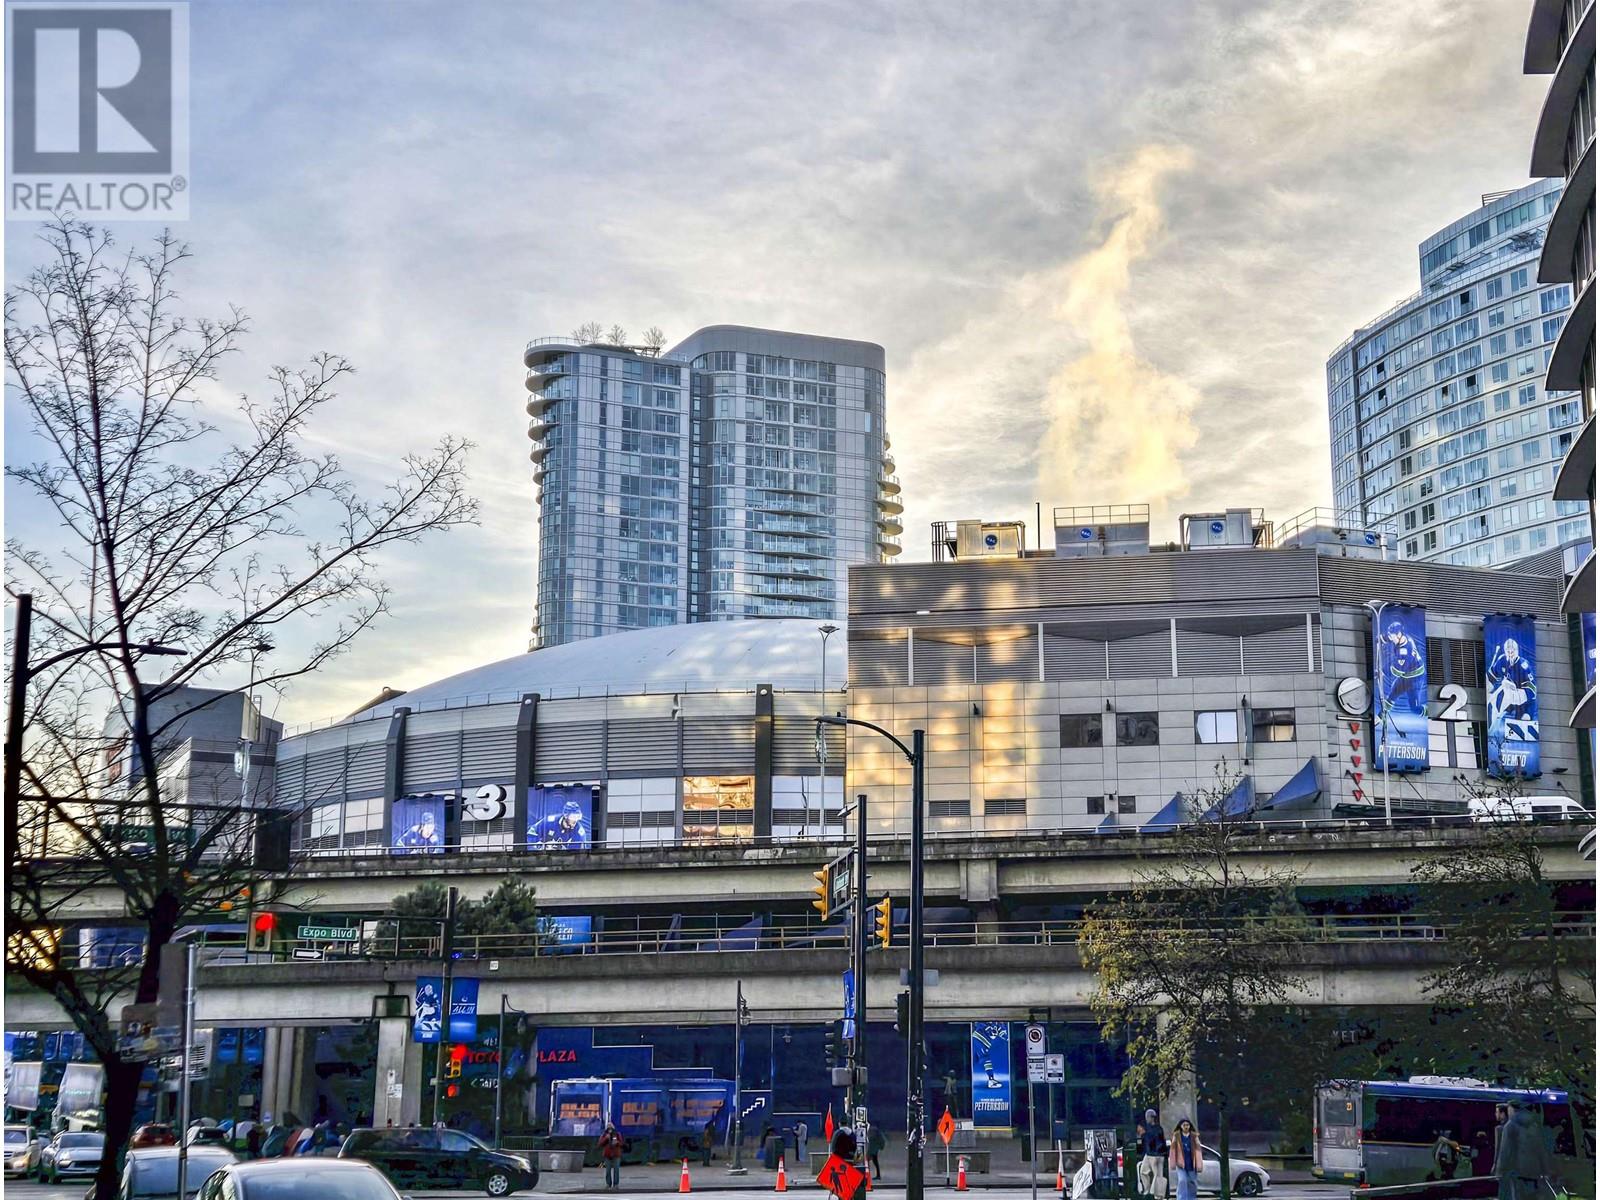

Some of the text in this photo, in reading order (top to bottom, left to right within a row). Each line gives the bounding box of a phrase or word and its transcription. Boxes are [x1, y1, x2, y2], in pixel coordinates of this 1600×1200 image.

[1439, 683, 1469, 720] 2
[1378, 745, 1426, 760] PTTERSSON
[466, 783, 507, 821] 3
[303, 927, 353, 938] Expo Blvd
[974, 1101, 1009, 1111] PETTERSSON
